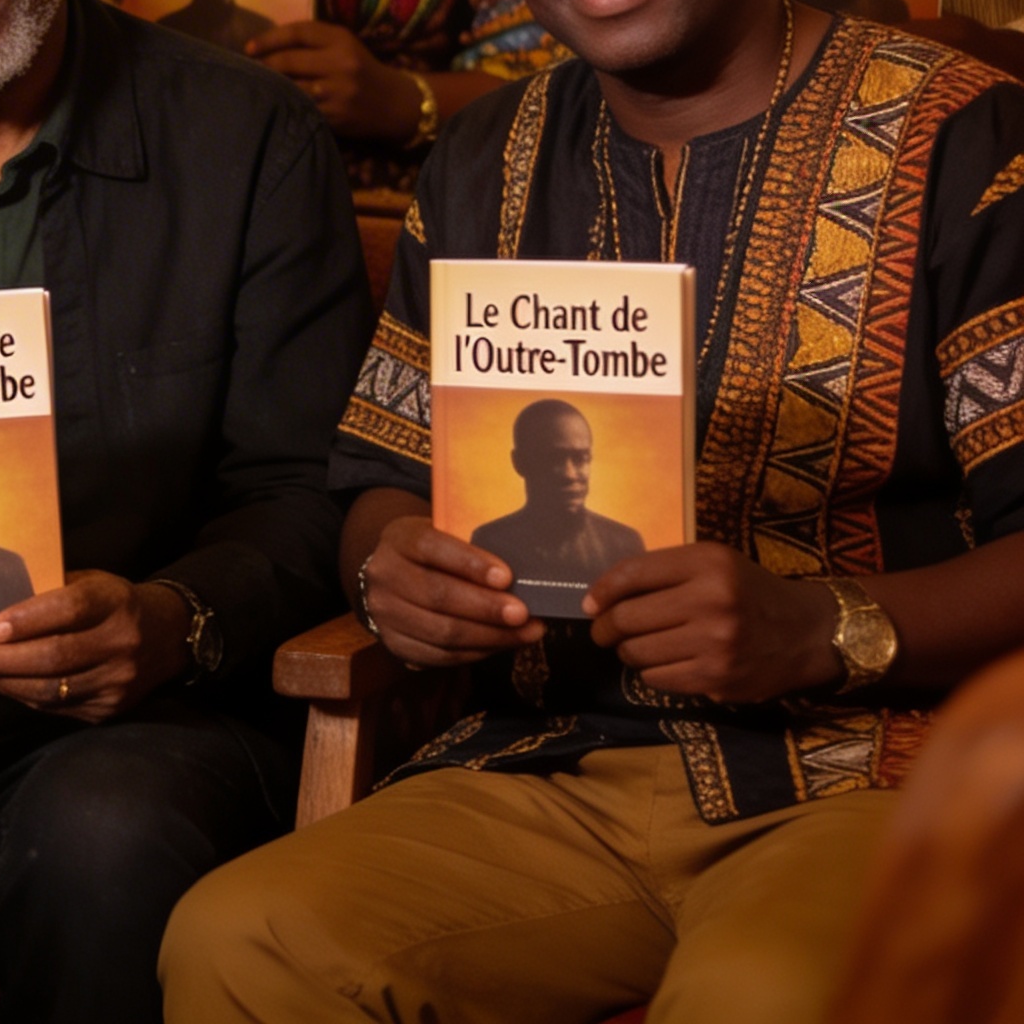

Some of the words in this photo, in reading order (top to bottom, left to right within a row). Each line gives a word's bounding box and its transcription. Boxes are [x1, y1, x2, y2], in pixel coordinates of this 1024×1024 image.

[465, 292, 499, 328] Le
[510, 293, 602, 331] Chant
[612, 295, 648, 332] de
[455, 334, 667, 378] l'Outre-Tombe
